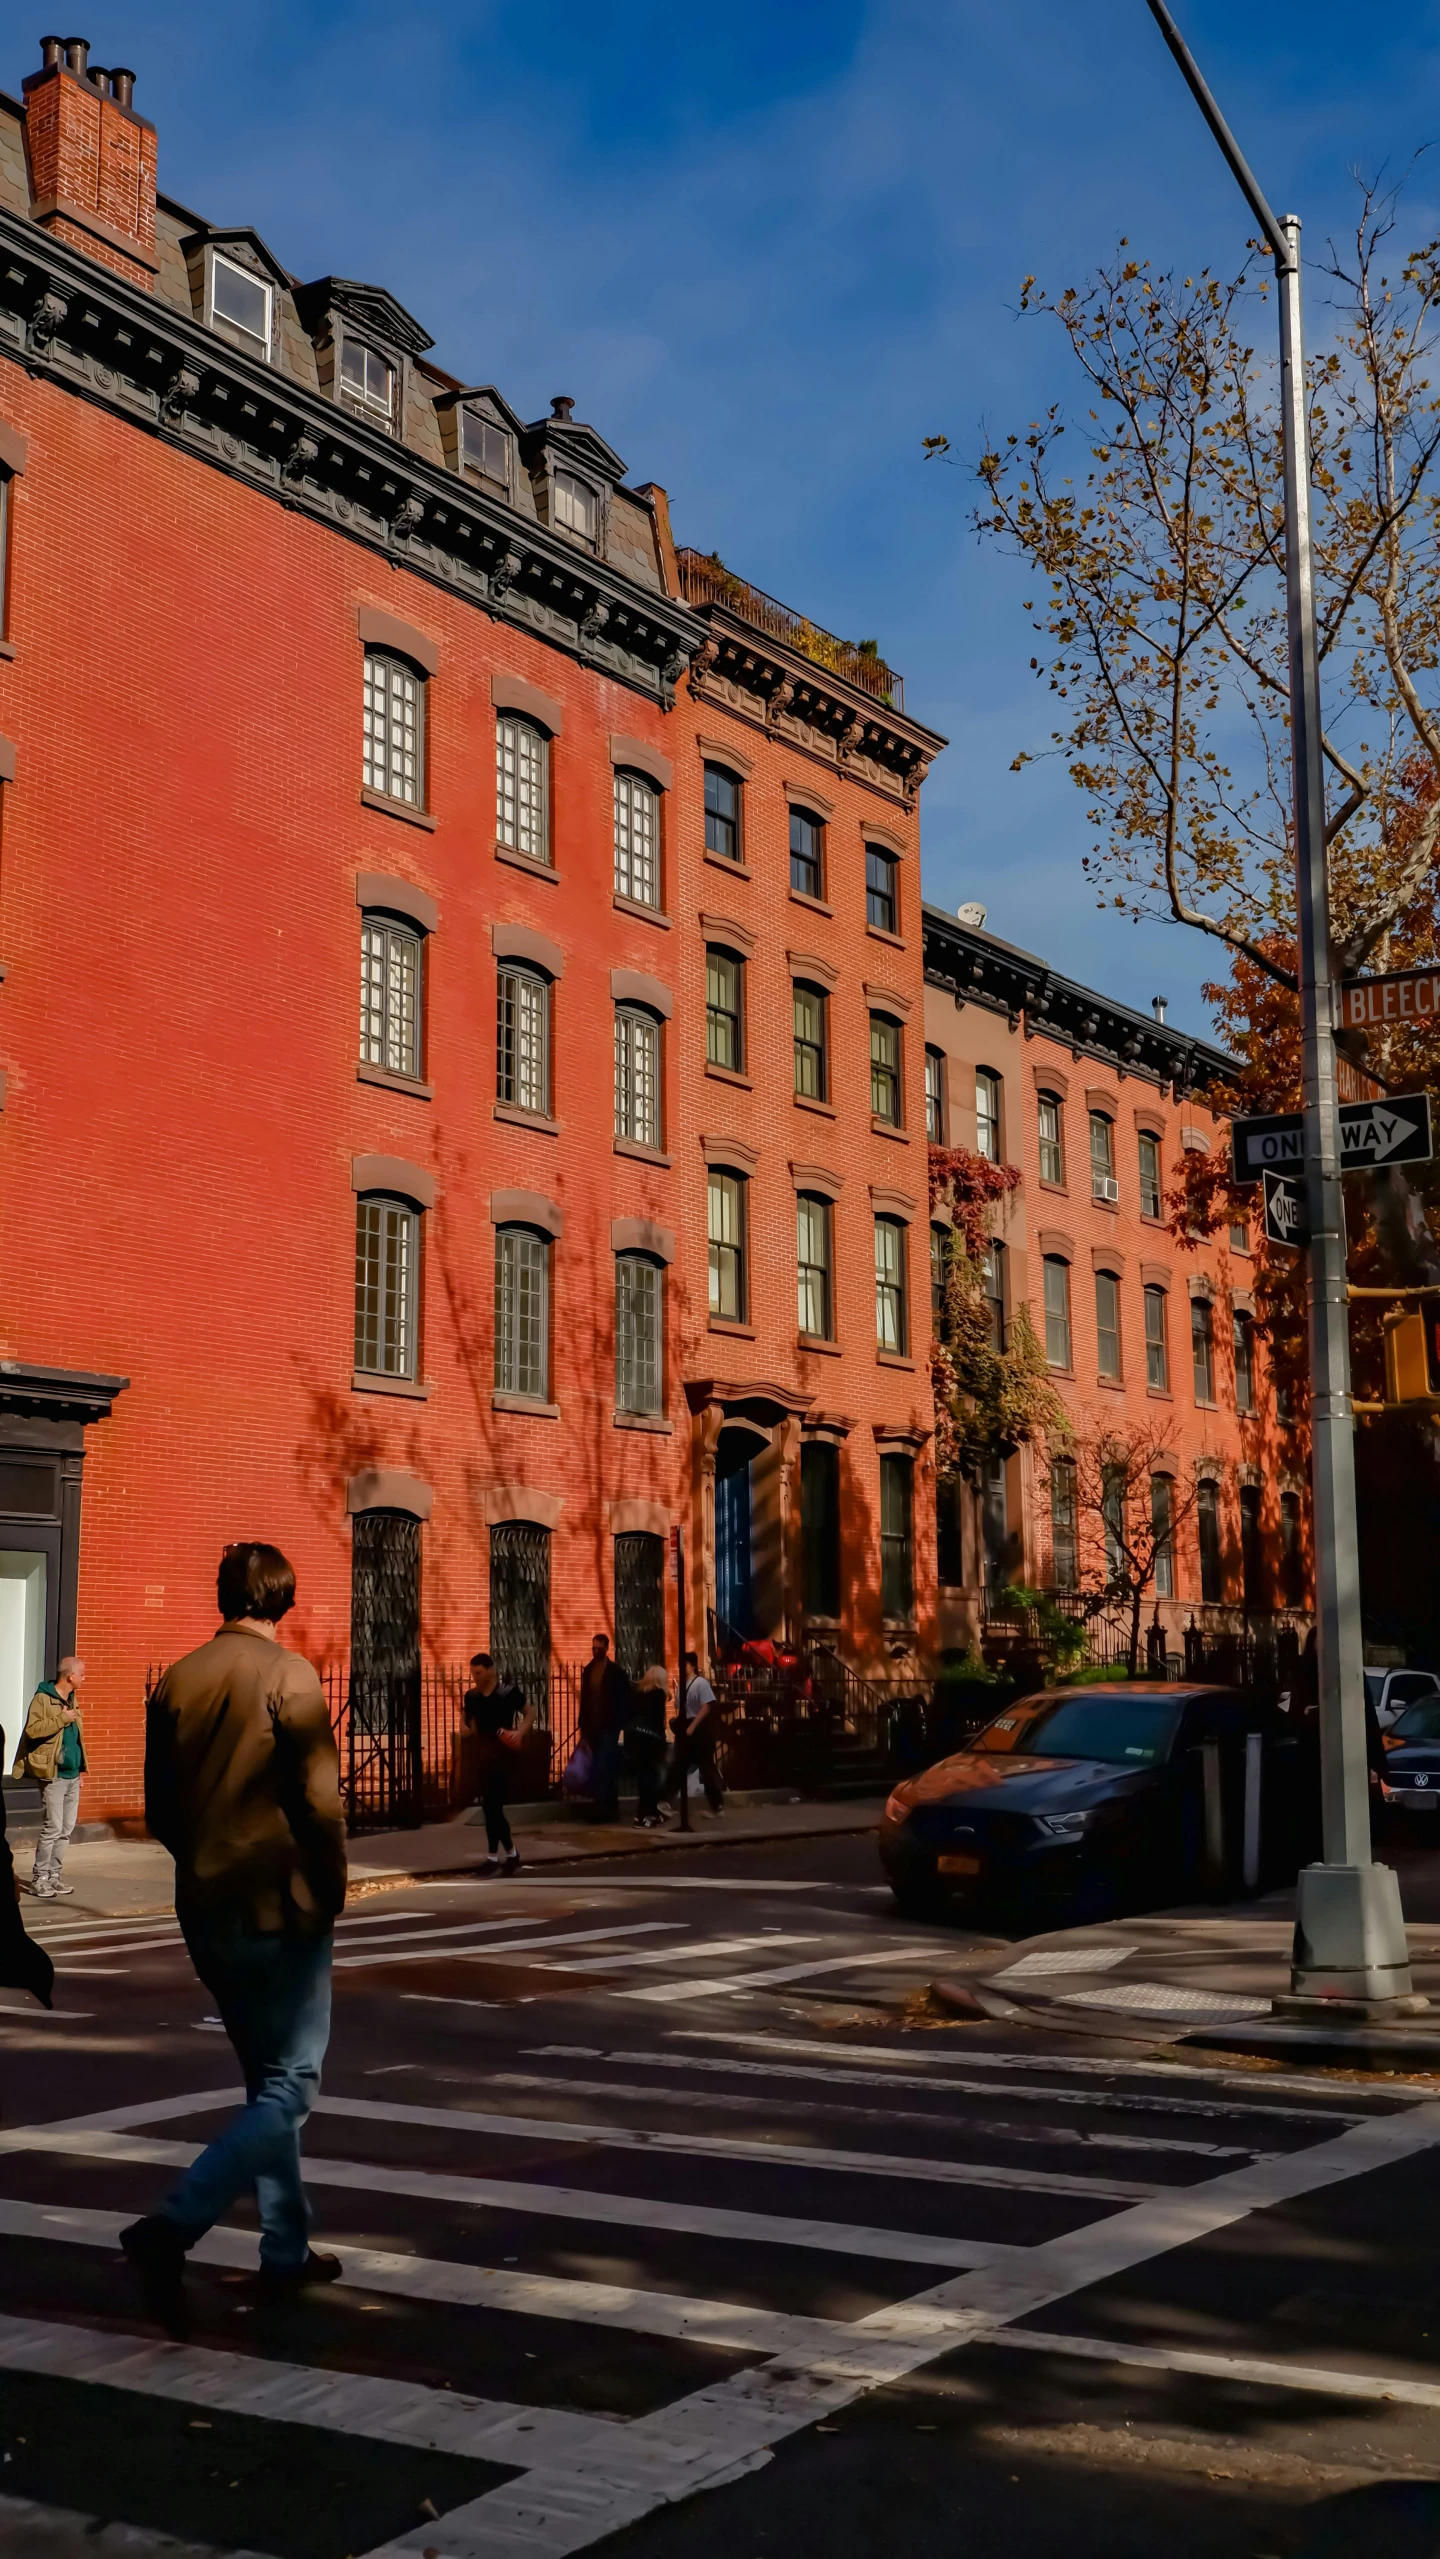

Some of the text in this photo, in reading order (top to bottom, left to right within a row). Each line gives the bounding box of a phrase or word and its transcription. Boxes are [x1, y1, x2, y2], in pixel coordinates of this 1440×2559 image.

[1338, 1056, 1373, 1102] HARLES
[1261, 1118, 1398, 1160] ON WAY
[1275, 1196, 1299, 1225] ONE
